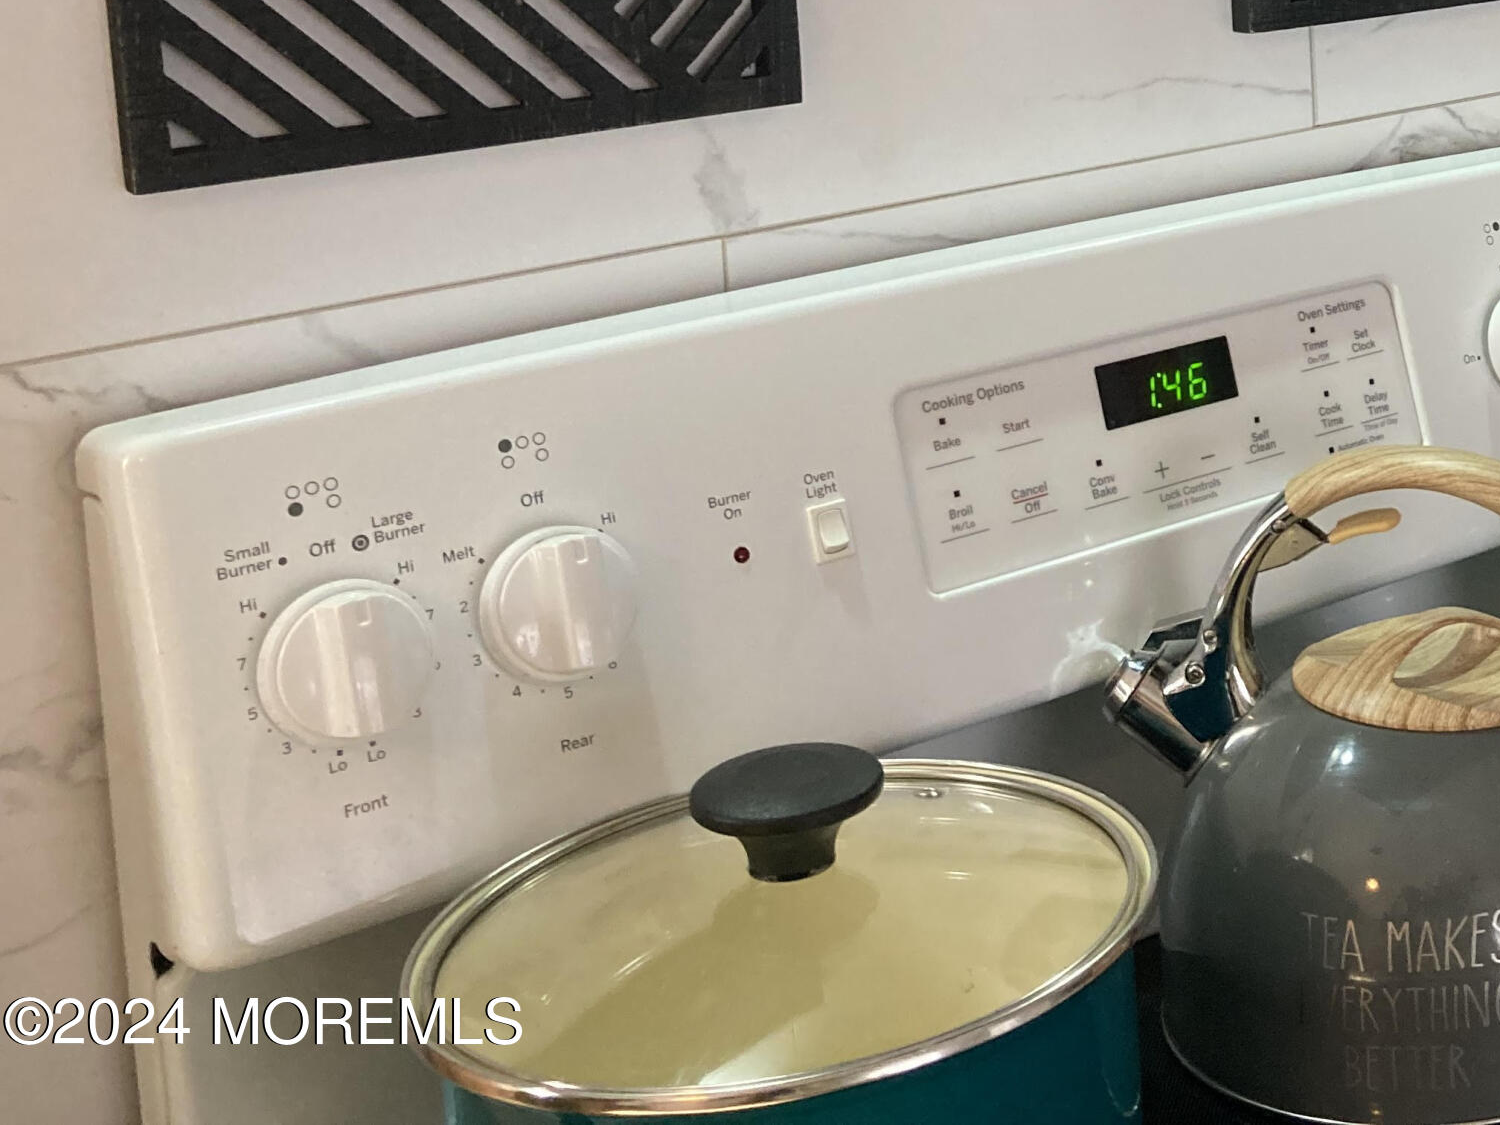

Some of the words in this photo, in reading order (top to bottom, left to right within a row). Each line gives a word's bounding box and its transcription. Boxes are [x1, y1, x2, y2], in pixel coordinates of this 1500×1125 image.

[1297, 308, 1324, 322] Oven
[1324, 298, 1366, 315] Settings
[1353, 328, 1368, 340] Set
[1302, 339, 1329, 352] Timer
[1351, 339, 1376, 353] Clock
[1463, 354, 1477, 365] On
[921, 393, 975, 413] Cooking
[976, 380, 1025, 401] Options
[1363, 391, 1388, 405] Delay
[1318, 403, 1342, 417] Cook
[1367, 403, 1390, 416] Time
[1002, 419, 1031, 434] Start
[1320, 415, 1344, 429] Time
[1251, 428, 1269, 443] Self
[932, 437, 962, 452] Bake
[1249, 440, 1277, 455] Clean
[803, 469, 835, 486] Oven
[1089, 474, 1116, 488] Conv
[806, 481, 838, 500] Light
[1010, 481, 1048, 500] Cancel
[1092, 485, 1119, 500] Bake
[1159, 489, 1181, 503] Lock
[1182, 478, 1222, 495] Controls
[520, 490, 545, 507] Off
[707, 490, 752, 509] Burner
[723, 508, 743, 520] On
[948, 504, 974, 521] Broil
[1024, 500, 1041, 514] Off
[371, 510, 414, 529] Large
[600, 511, 617, 525] Hi
[374, 522, 426, 544] Burner
[223, 541, 271, 563] Small
[308, 538, 337, 557] Off
[442, 545, 476, 564] Melt
[216, 559, 273, 581] Burner
[397, 561, 415, 575] Hi
[239, 598, 258, 614] Hi
[459, 600, 469, 614] 2
[425, 608, 435, 620] 7
[236, 657, 247, 671] 7
[472, 654, 482, 667] 3
[512, 685, 522, 698] 4
[564, 686, 574, 700] 5
[247, 707, 258, 721] 5
[281, 741, 292, 755] 3
[560, 733, 596, 753] Rear
[367, 749, 387, 763] Lo
[328, 761, 348, 775] Lo
[344, 794, 389, 818] Front
[1299, 911, 1366, 973] TEA
[1342, 1042, 1472, 1092] BETTER
